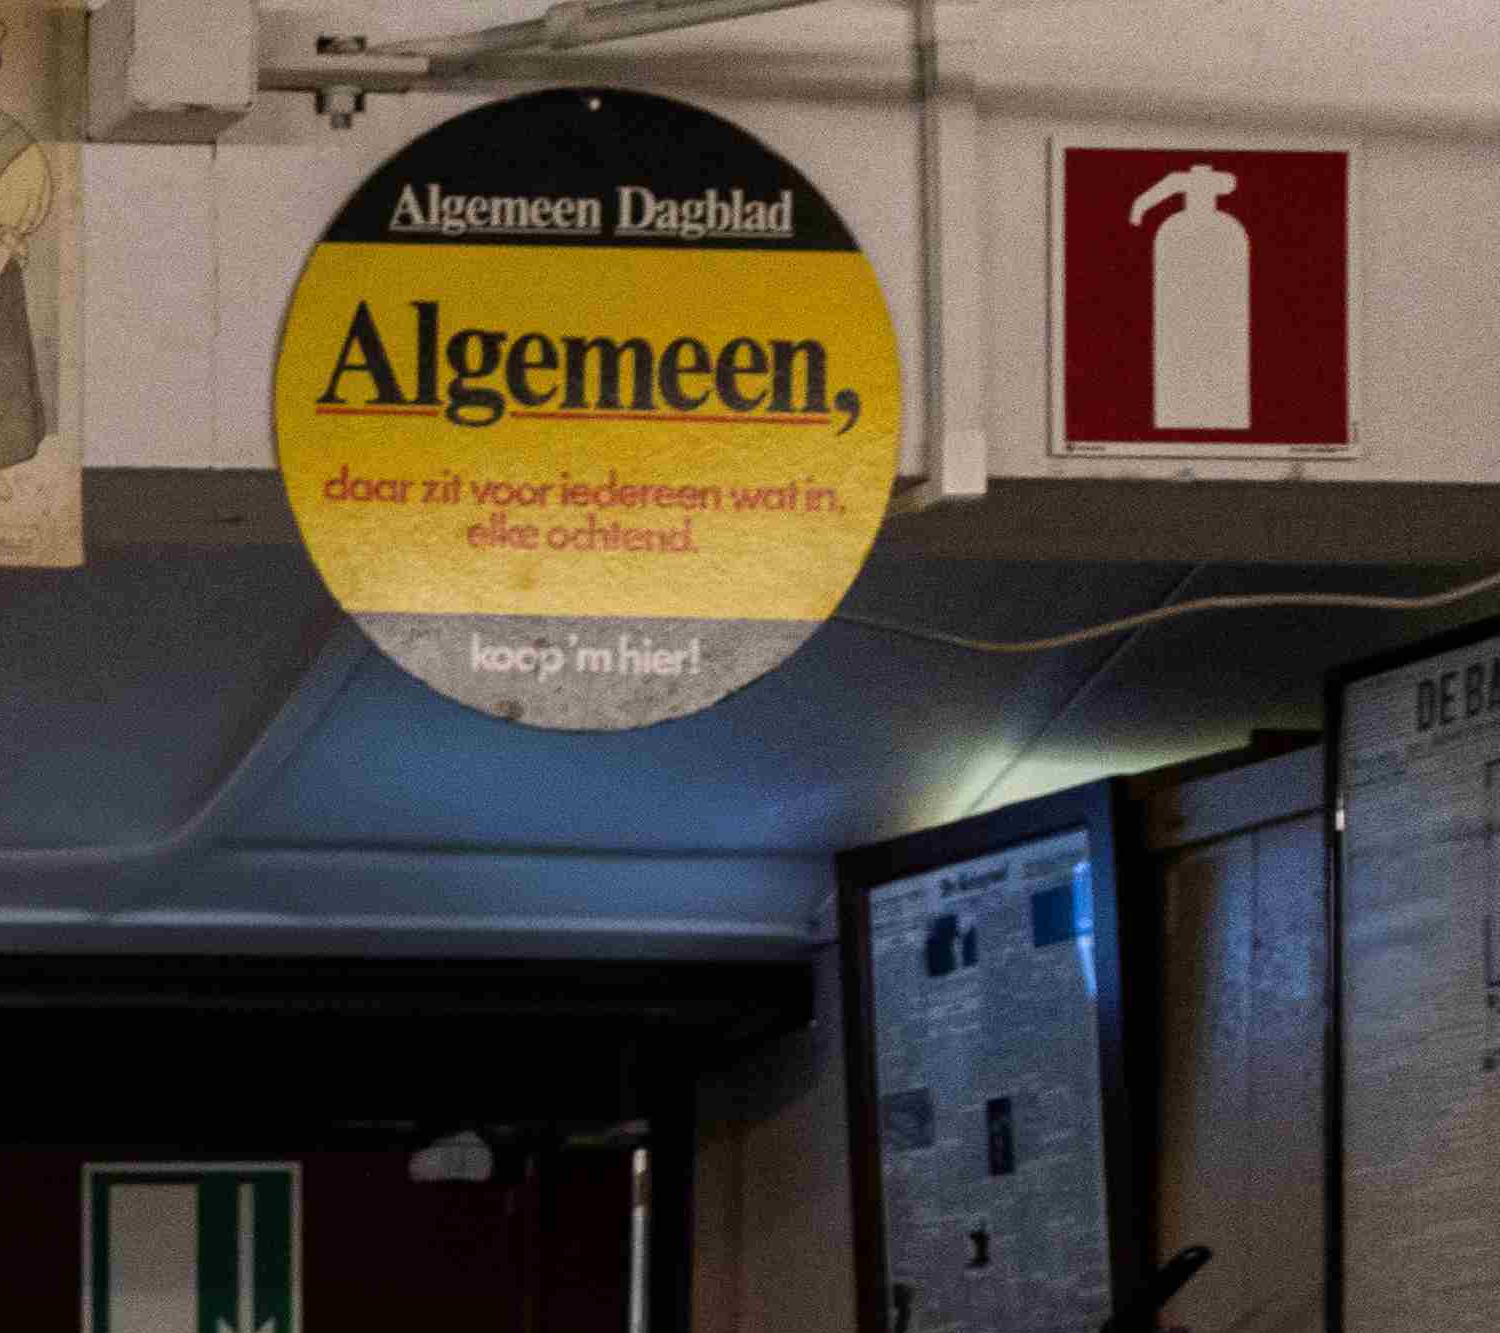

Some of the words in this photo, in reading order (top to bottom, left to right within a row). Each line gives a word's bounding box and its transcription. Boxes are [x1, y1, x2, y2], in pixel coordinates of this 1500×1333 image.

[389, 183, 600, 237] Algemeen
[613, 185, 794, 240] Dagblad
[315, 299, 862, 435] Algemeen,
[323, 465, 414, 503] daar
[421, 468, 462, 505] zit
[470, 478, 548, 508] voor
[559, 470, 722, 511] iedereen
[730, 476, 800, 514] wat
[804, 476, 847, 516] in,
[466, 513, 540, 550] elke
[546, 514, 701, 553] ochtend.
[469, 634, 564, 682] koop
[618, 637, 701, 677] hier!
